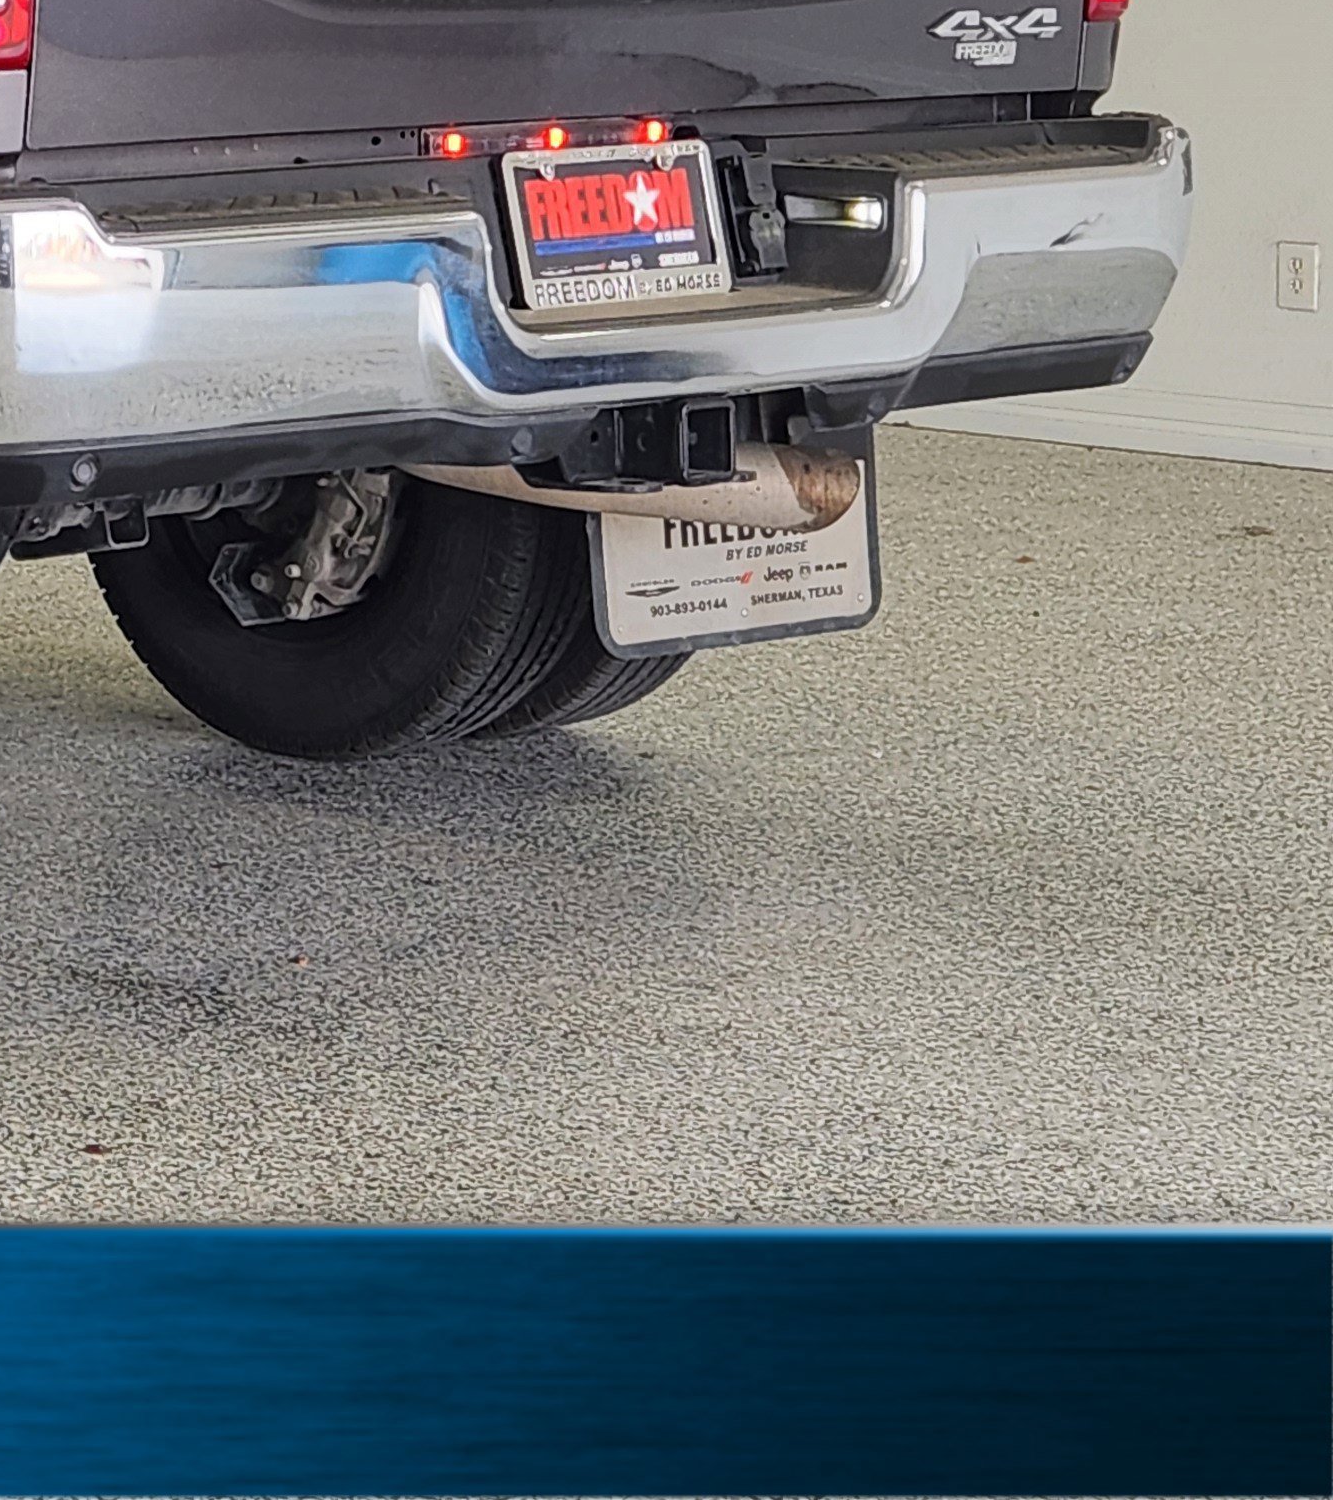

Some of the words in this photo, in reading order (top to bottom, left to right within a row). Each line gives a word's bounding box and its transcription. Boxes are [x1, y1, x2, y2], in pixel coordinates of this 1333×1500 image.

[523, 168, 694, 240] FREEDOM
[535, 274, 637, 307] FREEDOM
[763, 566, 794, 582] Jeep
[808, 584, 844, 599] TEXAS
